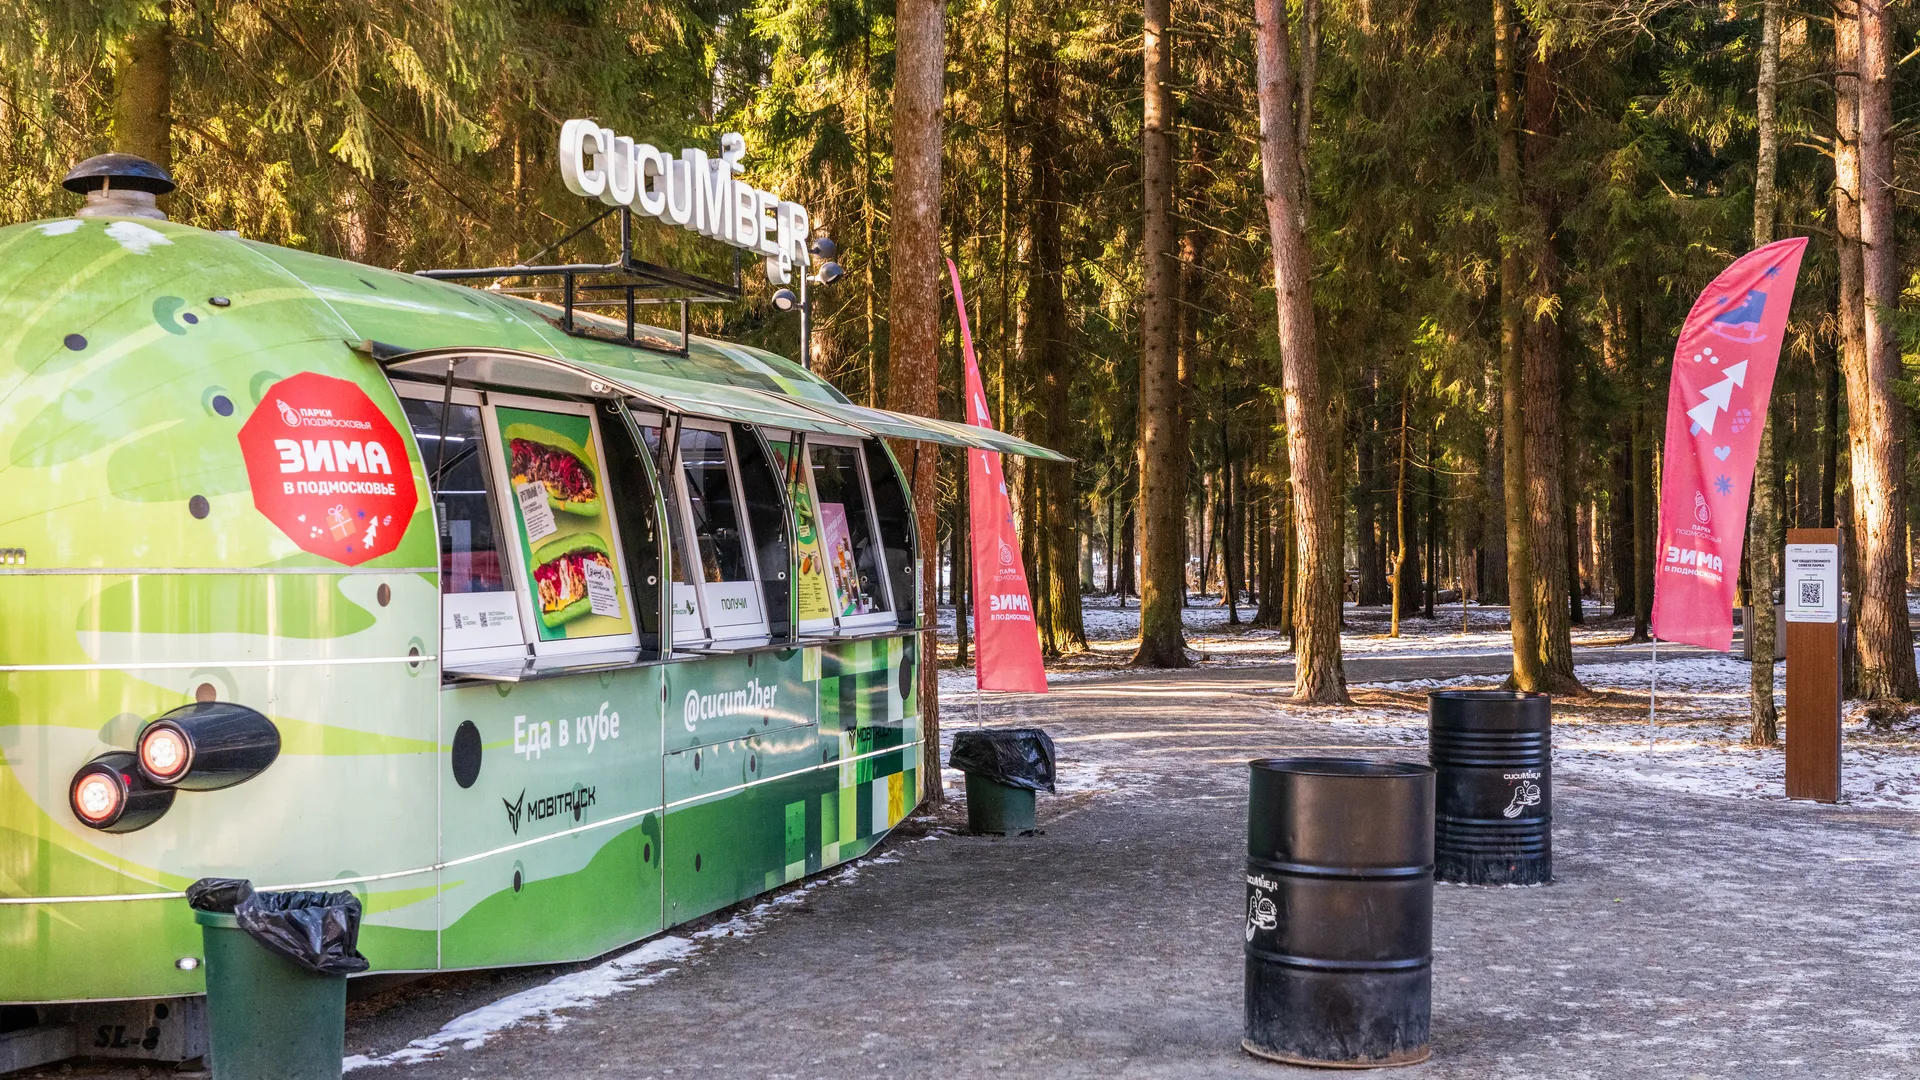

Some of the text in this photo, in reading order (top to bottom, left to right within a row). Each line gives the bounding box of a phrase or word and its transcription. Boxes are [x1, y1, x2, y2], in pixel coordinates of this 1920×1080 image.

[299, 408, 333, 417] ПАРКИ
[302, 418, 372, 430] ПОДМОСКОВЬЯ
[273, 438, 393, 475] ЗИМА
[283, 481, 397, 496] В ПОДМОСКОВЬЕ
[1691, 524, 1711, 534] ПАРКИ
[1666, 545, 1723, 574] ЗИМА
[1671, 566, 1723, 583] ПОДМОСКОВЬЕ
[721, 598, 748, 610] ПОЛУЧИ
[989, 594, 1030, 611] ЗИМА
[996, 613, 1031, 622] ПОДМОСКОВЬЕ
[684, 677, 778, 733] @cucum2ber
[514, 700, 620, 761] Еда в кубе
[527, 785, 596, 823] MOBITRUCK
[94, 1024, 161, 1051] SL-8
